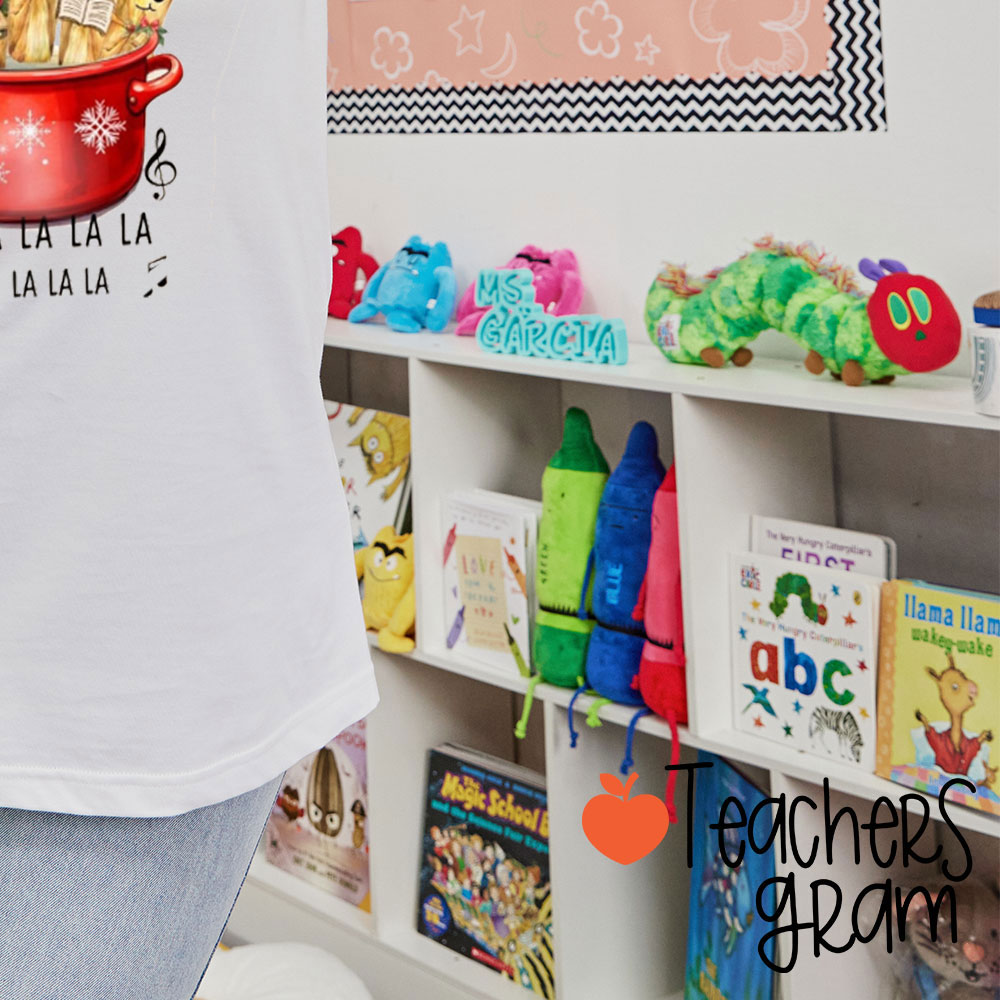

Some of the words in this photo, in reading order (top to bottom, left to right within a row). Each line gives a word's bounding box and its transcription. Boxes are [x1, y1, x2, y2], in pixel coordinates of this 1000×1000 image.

[21, 215, 53, 250] LA
[71, 213, 103, 247] LA
[121, 211, 153, 246] LA
[11, 269, 38, 299] LA
[48, 268, 75, 297] LA
[84, 266, 111, 295] LA
[479, 312, 617, 364] GARCIA
[798, 535, 824, 550] Hungry
[904, 593, 955, 628] llama
[911, 626, 994, 658] wakey-wake
[750, 637, 856, 706] abc
[441, 772, 487, 810] Magic
[487, 788, 540, 832] School
